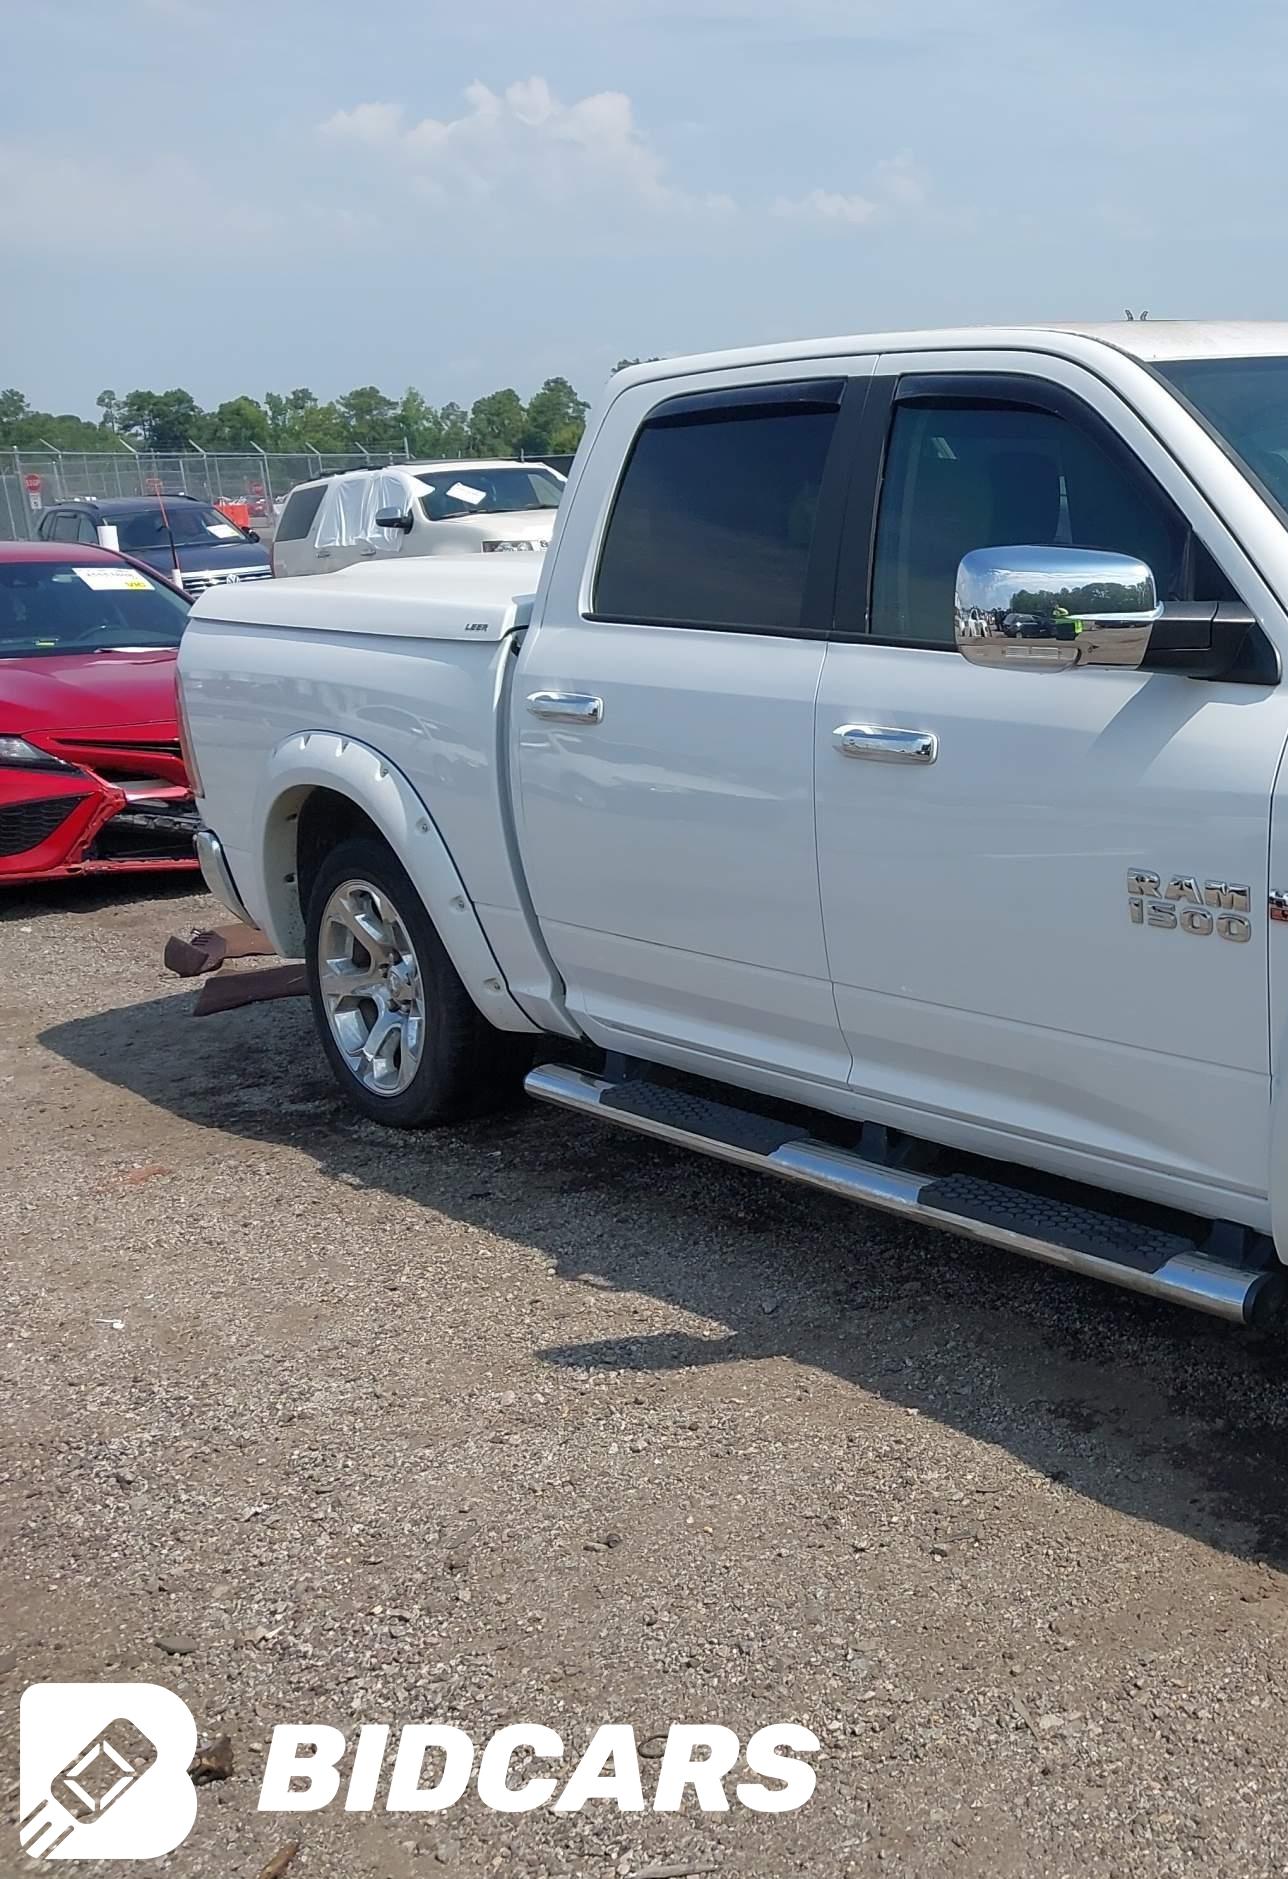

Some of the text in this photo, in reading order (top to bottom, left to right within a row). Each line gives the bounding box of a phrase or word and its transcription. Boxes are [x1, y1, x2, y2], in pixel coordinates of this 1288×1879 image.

[464, 623, 489, 632] LEER
[1127, 867, 1251, 912] RAM
[1129, 897, 1252, 943] 1500
